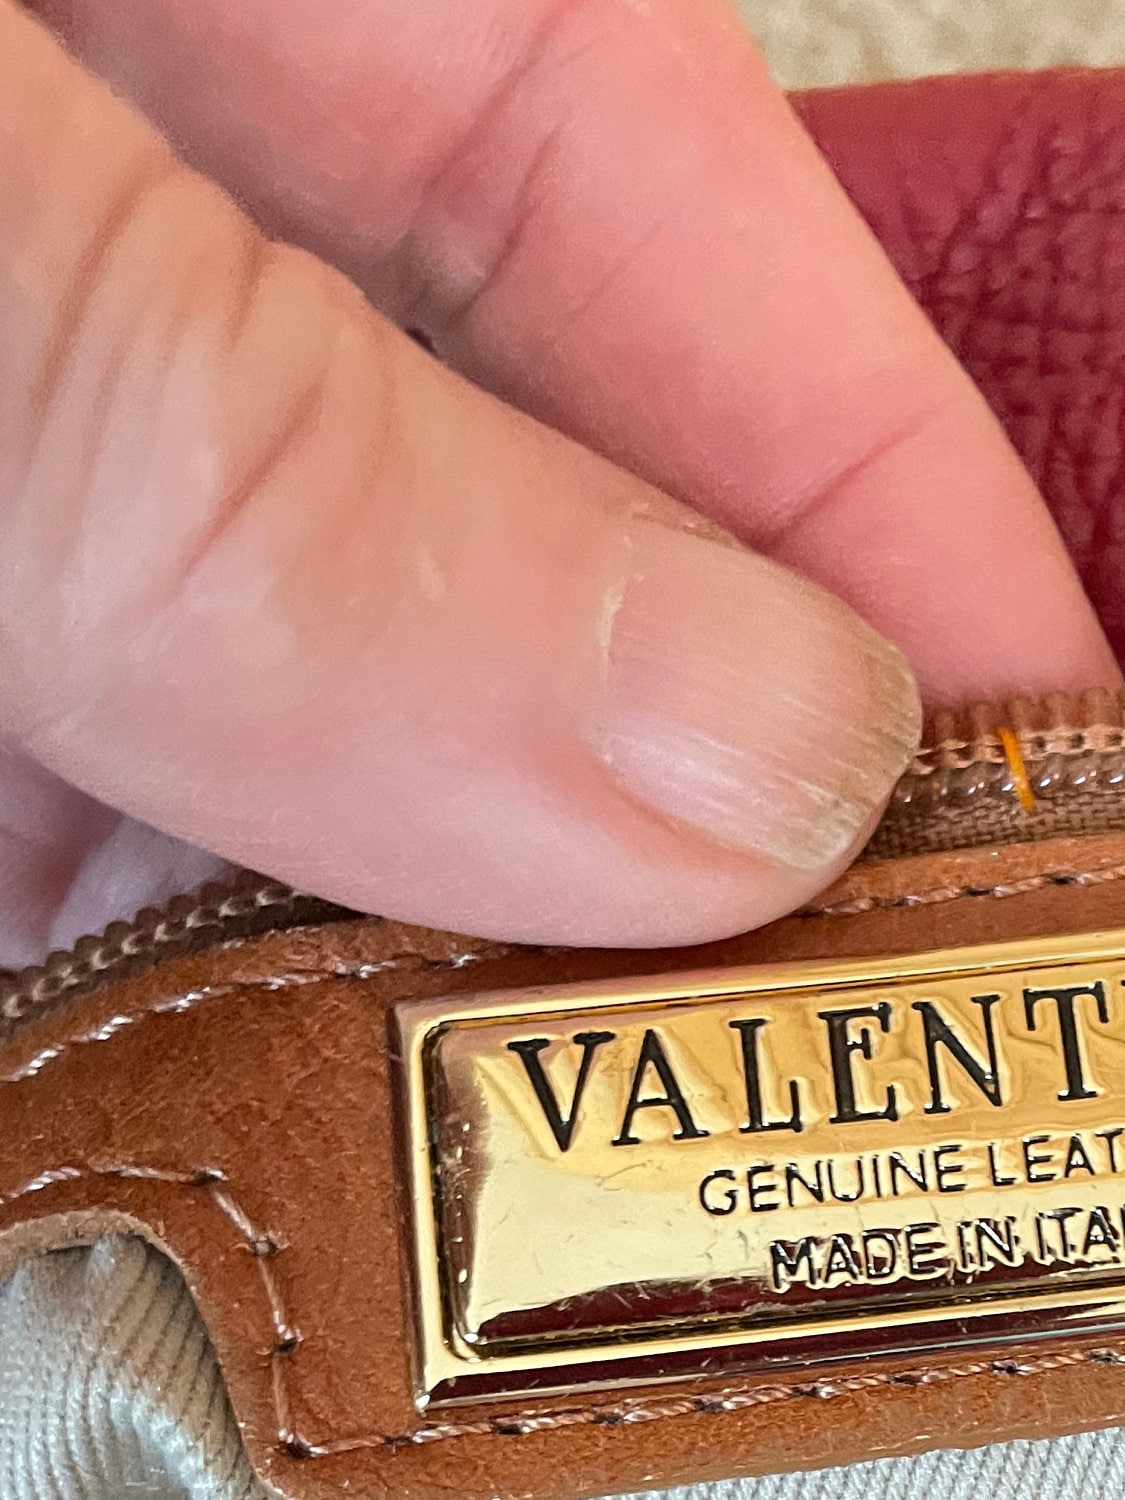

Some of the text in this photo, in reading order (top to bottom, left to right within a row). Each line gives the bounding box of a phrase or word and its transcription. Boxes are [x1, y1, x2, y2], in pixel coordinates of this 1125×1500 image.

[698, 1144, 966, 1217] GENUINE
[769, 1224, 945, 1291] MADE
[953, 1219, 1024, 1274] IN
